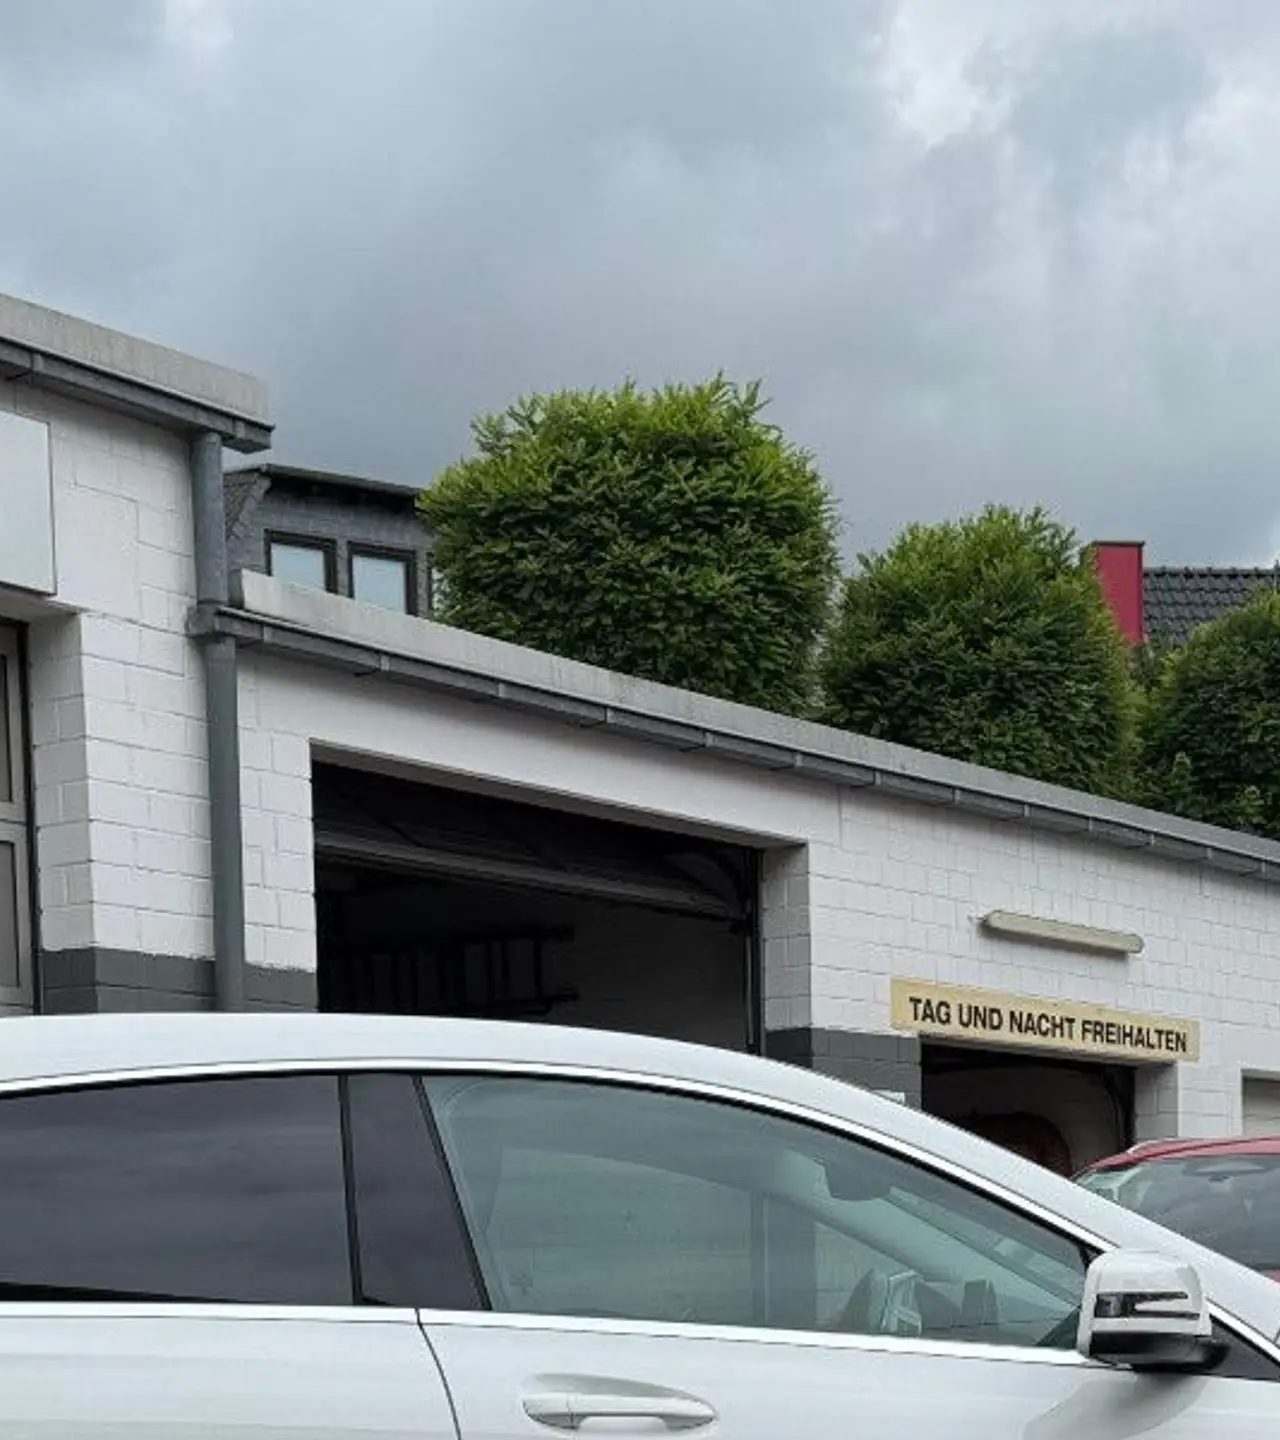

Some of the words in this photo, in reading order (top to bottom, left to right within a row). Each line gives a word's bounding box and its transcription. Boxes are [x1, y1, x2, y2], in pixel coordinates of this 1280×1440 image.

[909, 996, 951, 1026] TAG
[959, 1004, 1003, 1030] UND
[1009, 1011, 1076, 1039] NACHT
[1081, 1019, 1187, 1052] FREIHALTEN
